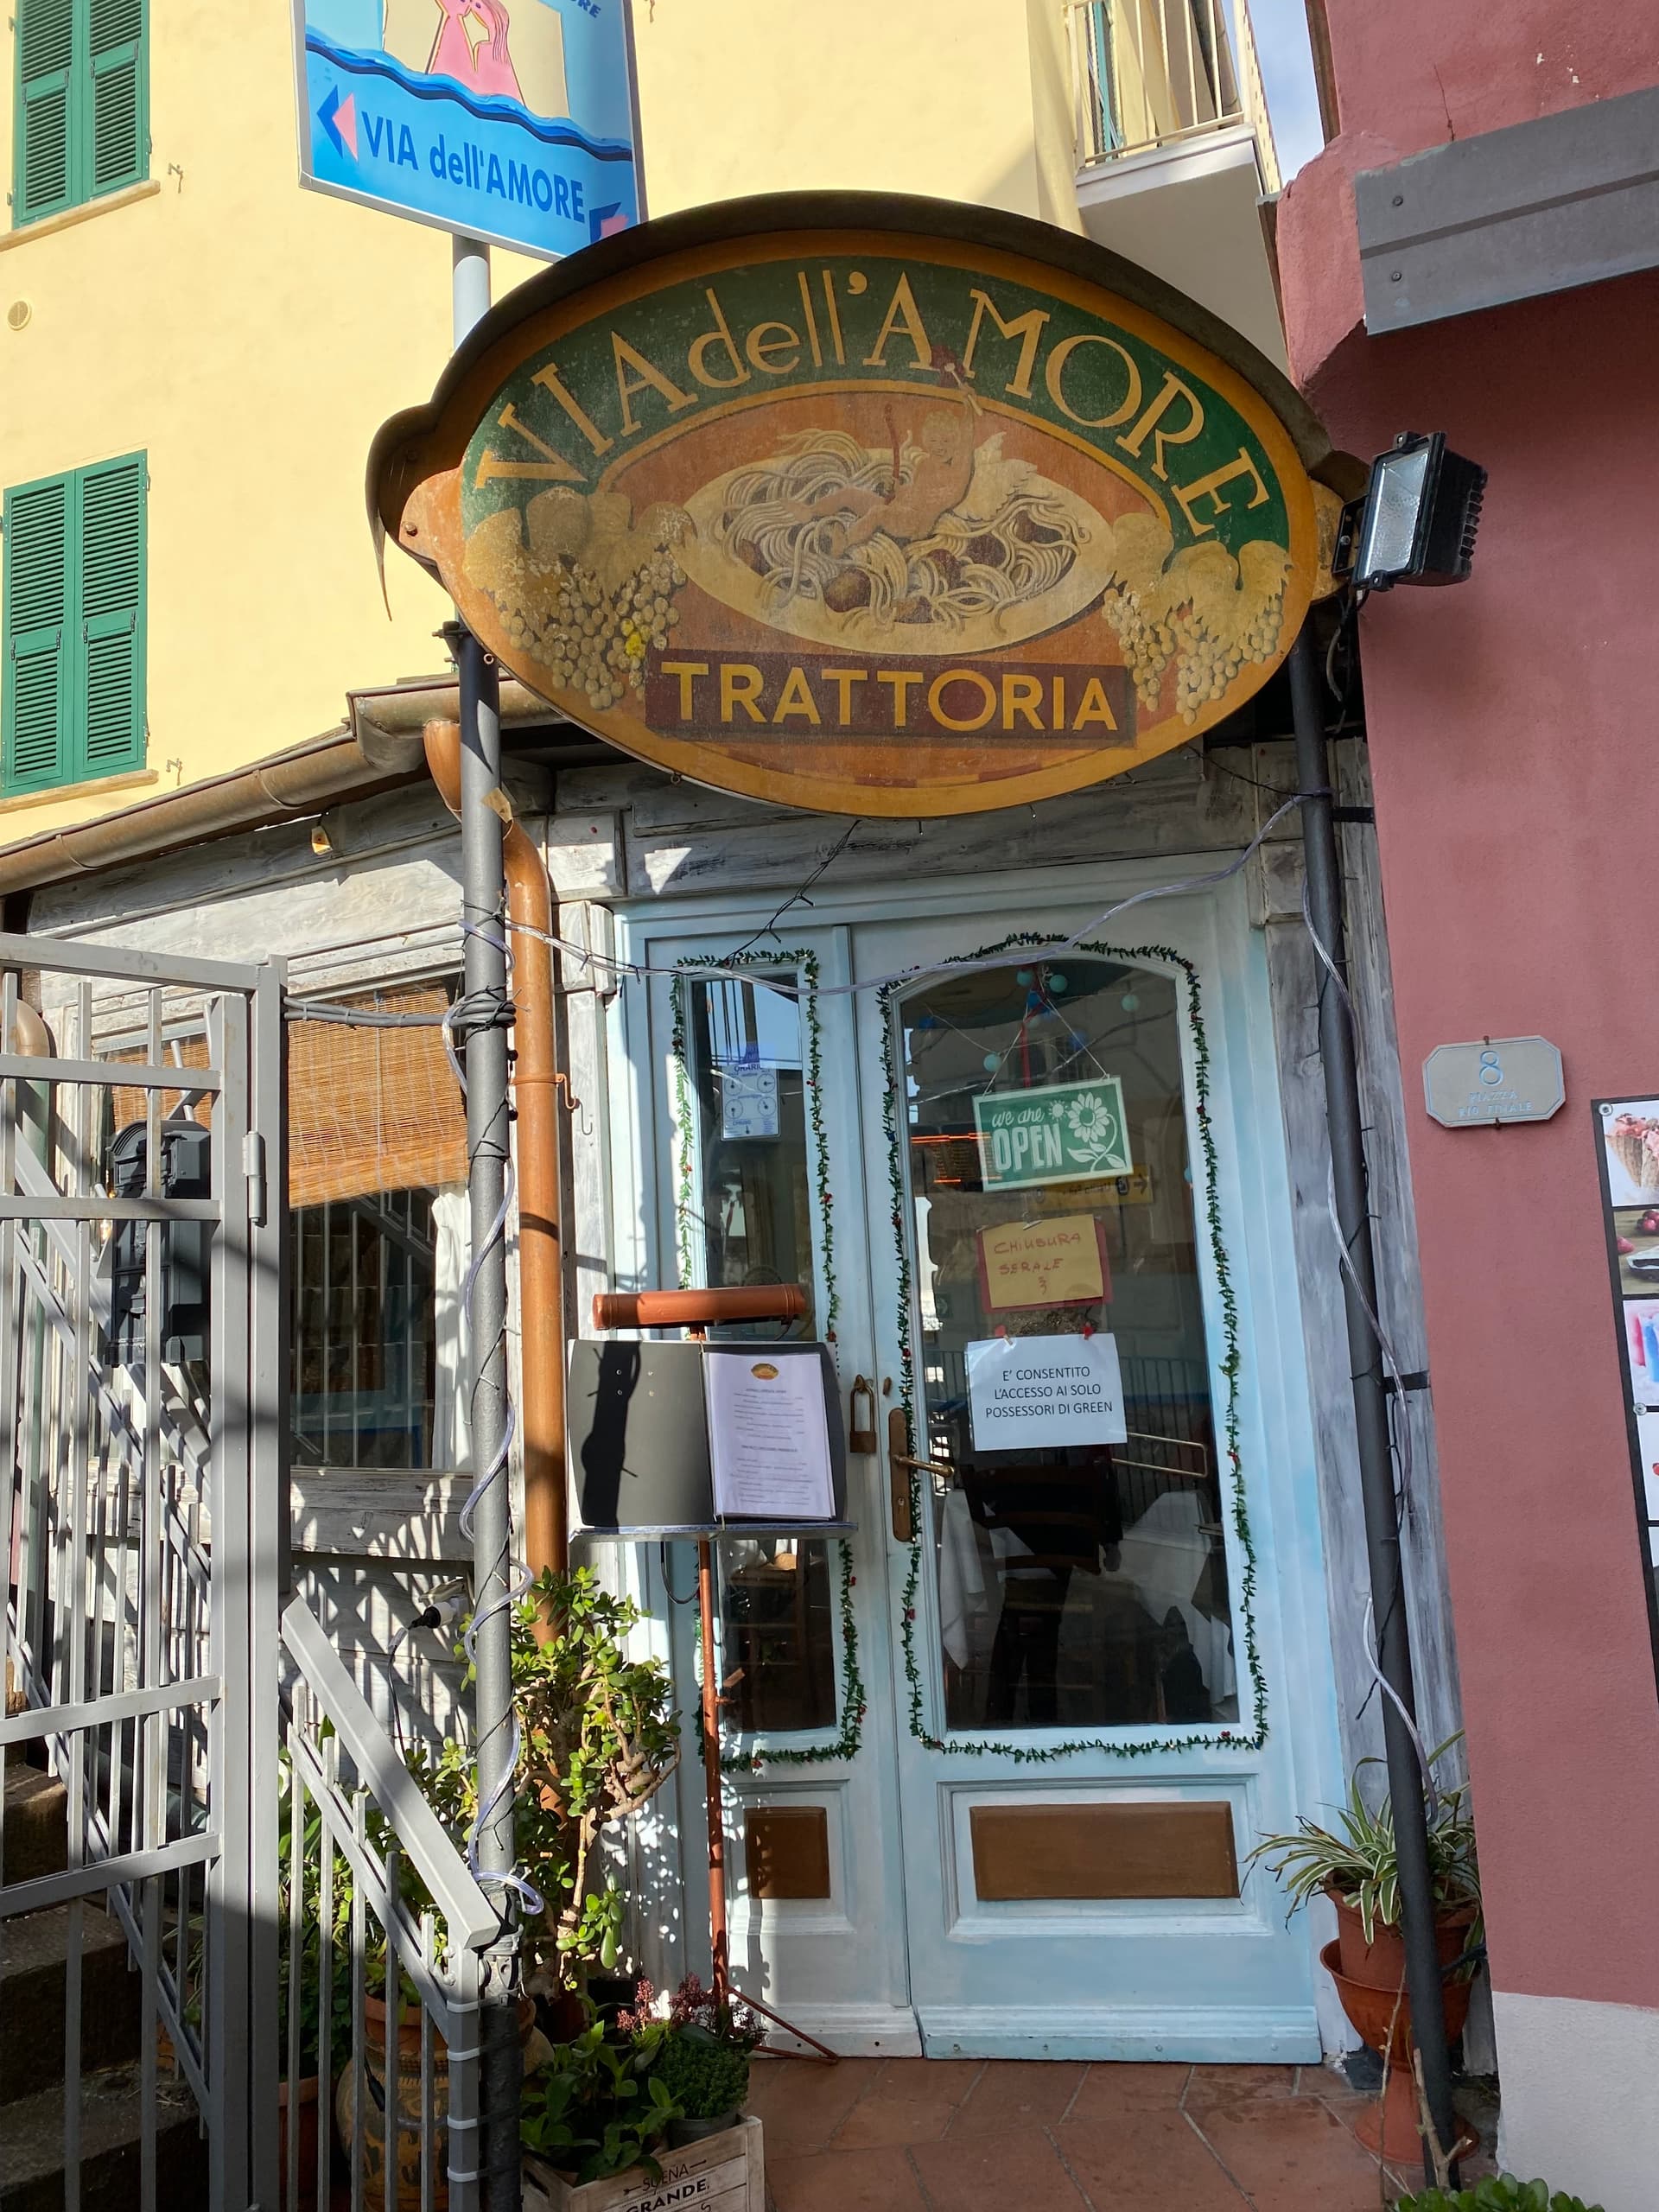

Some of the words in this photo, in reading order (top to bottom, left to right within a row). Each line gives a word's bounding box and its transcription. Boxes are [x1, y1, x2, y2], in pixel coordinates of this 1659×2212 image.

[362, 111, 419, 170] VIA
[429, 134, 585, 224] dell'AMORE
[475, 327, 701, 491] VIA
[660, 662, 1118, 733] TRATTORIA
[1479, 1050, 1504, 1086] 8
[1470, 1090, 1517, 1103] PIAZZA
[992, 1111, 1014, 1127] we
[1018, 1107, 1045, 1123] are
[1458, 1107, 1478, 1118] RIO
[993, 1123, 1063, 1173] OPEN
[999, 1258, 1064, 1275] SERALE
[1016, 1366, 1090, 1381] CONSENTITO
[995, 1386, 1053, 1400] L'ACCESSO
[1056, 1385, 1068, 1396] AI
[1071, 1383, 1102, 1396] SOLO
[986, 1405, 1055, 1419] POSSESSORI
[1058, 1403, 1071, 1414] DI
[1073, 1402, 1113, 1414] GREEN
